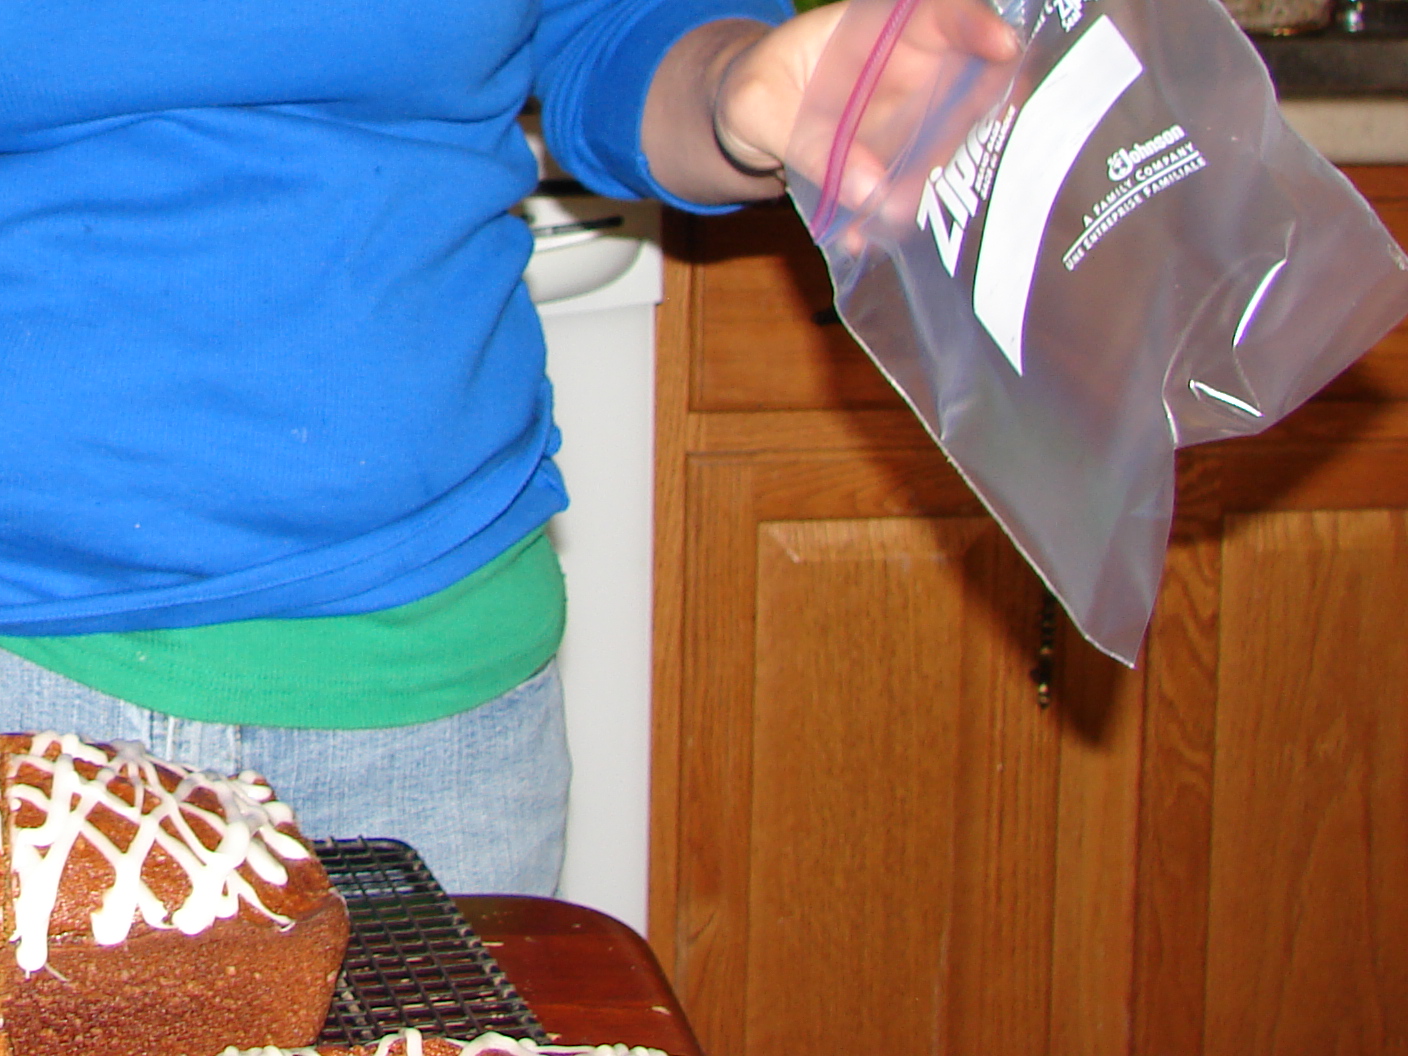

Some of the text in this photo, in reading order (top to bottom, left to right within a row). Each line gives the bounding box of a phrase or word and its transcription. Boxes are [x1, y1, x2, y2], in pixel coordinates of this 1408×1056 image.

[1083, 215, 1093, 229] A
[1135, 142, 1194, 182] COMPANY
[1108, 125, 1186, 181] Johnson
